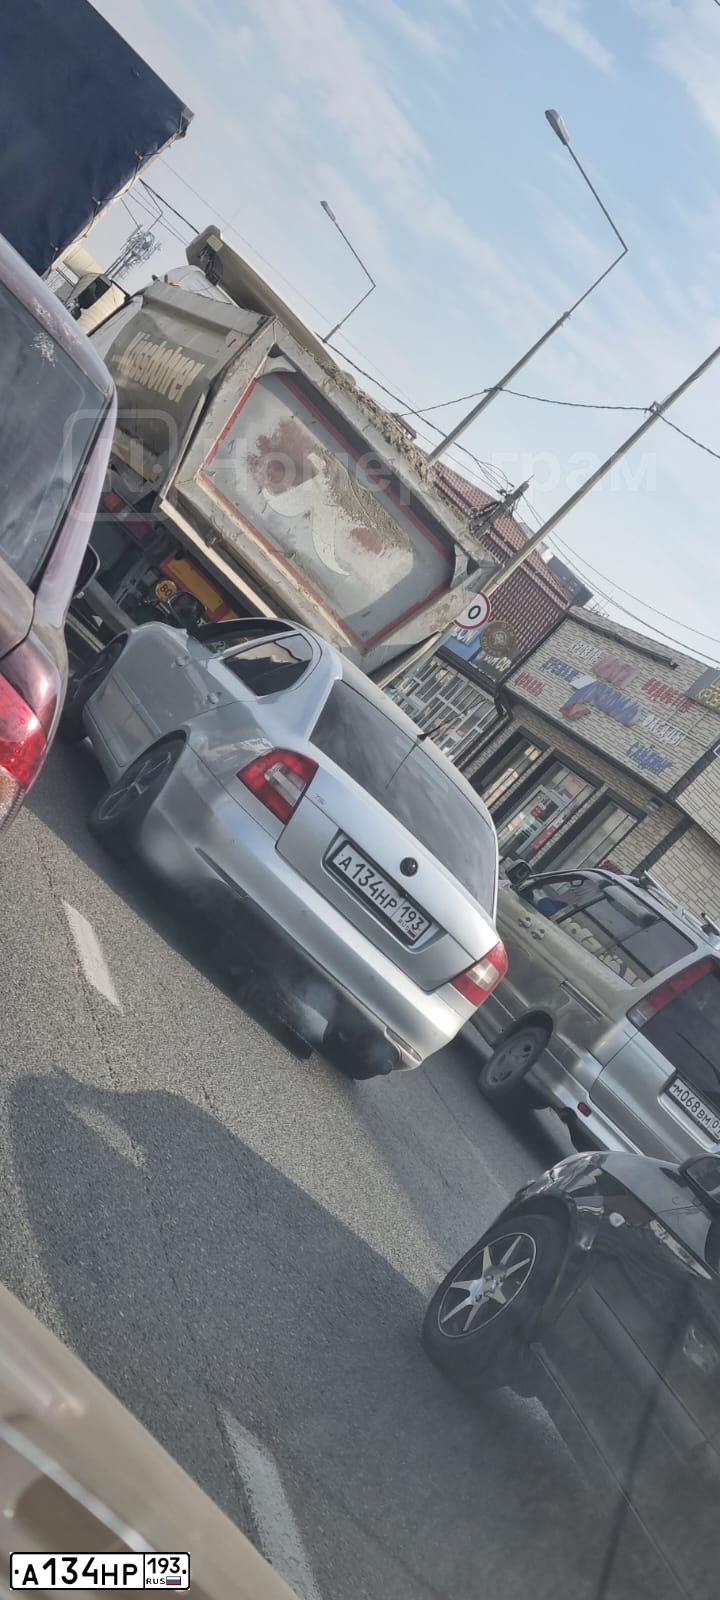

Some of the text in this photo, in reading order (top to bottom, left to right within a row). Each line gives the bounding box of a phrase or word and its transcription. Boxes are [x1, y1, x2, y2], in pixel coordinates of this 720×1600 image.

[160, 584, 172, 597] 80
[468, 605, 481, 620] 0
[338, 856, 425, 931] А134НР 193
[673, 1086, 712, 1126] М068ВМ
